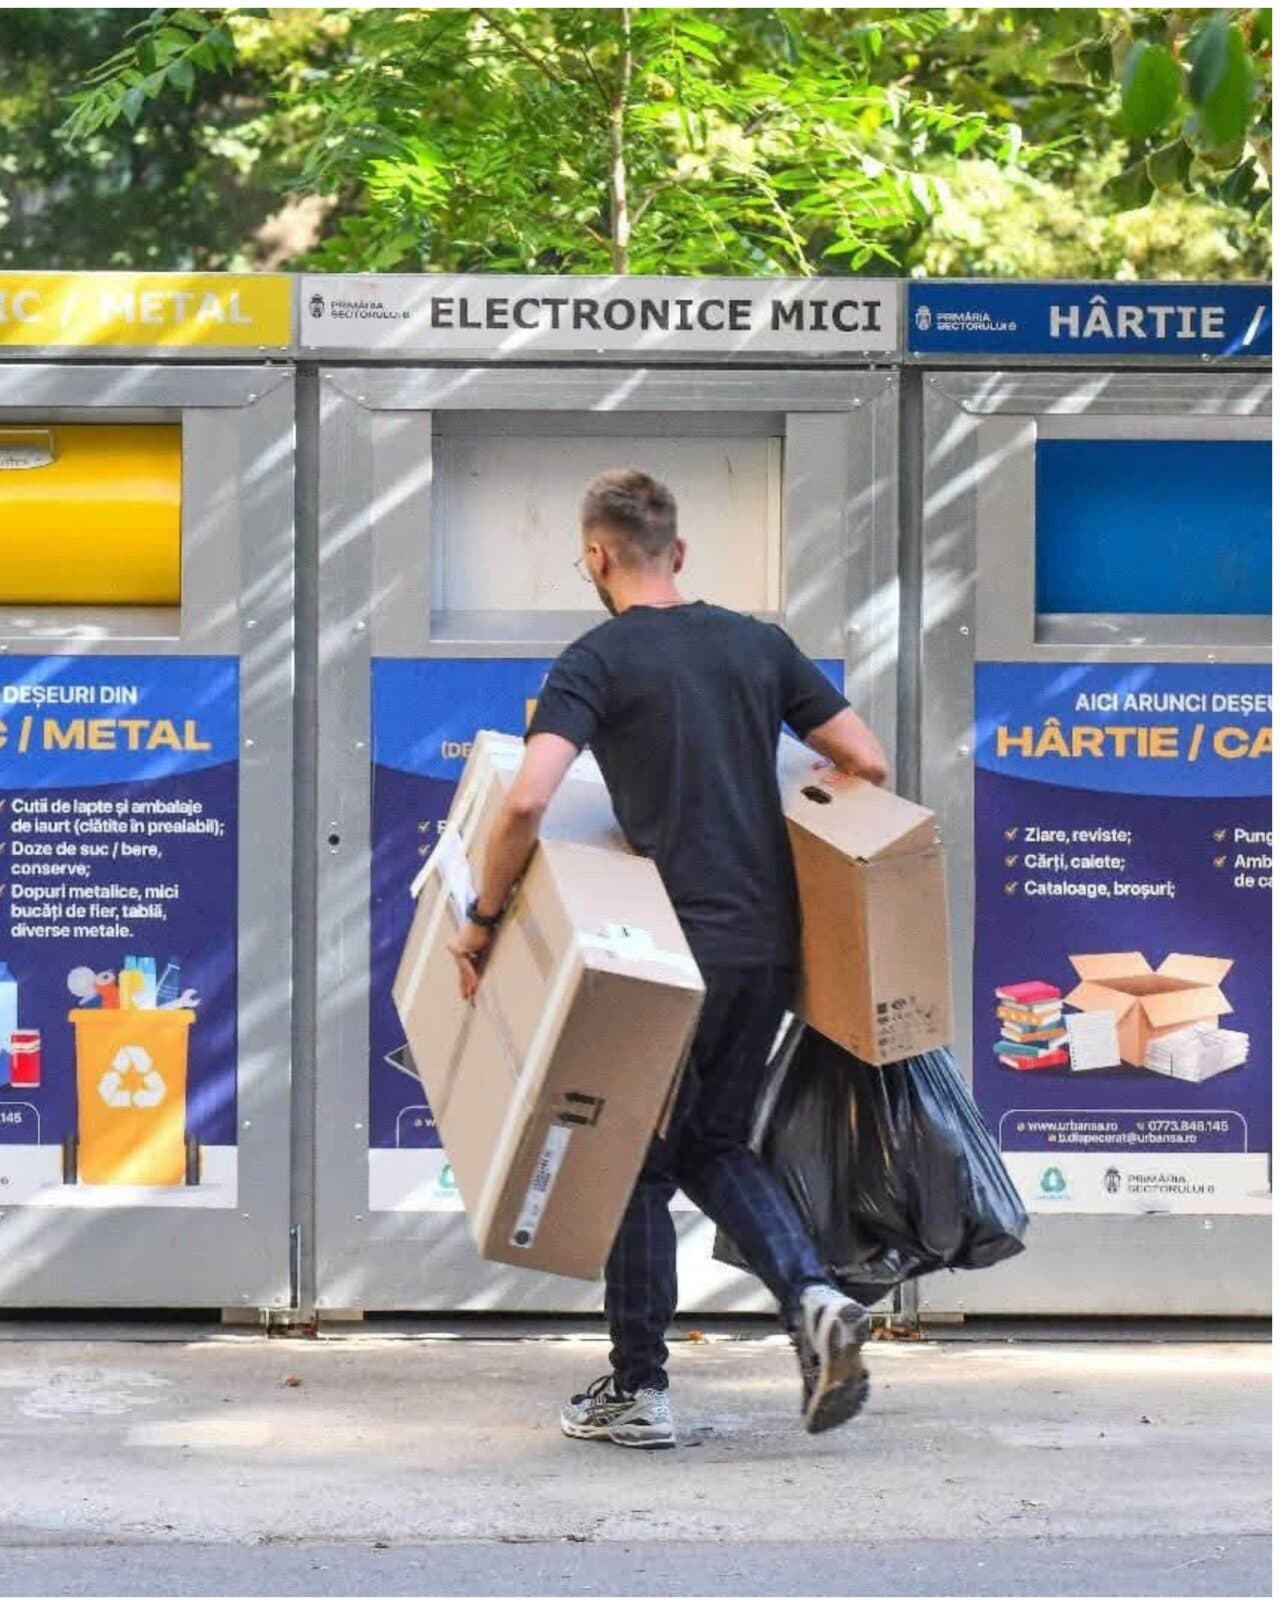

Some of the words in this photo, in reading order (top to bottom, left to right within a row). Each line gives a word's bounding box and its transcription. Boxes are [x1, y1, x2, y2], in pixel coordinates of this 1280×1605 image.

[99, 289, 252, 325] METAL
[429, 297, 752, 331] ELECTRONICE
[770, 299, 882, 332] MICI
[1049, 294, 1226, 339] HÂRTIE
[1241, 304, 1266, 346] /
[3, 685, 95, 710] DEȘEURI
[99, 685, 138, 704] DIN
[1075, 693, 1118, 712] AICI
[1123, 693, 1207, 713] ARUNCI
[17, 715, 34, 754] /
[42, 718, 213, 751] METAL
[996, 716, 1180, 758] HÂRTIE
[1187, 723, 1205, 762] /
[11, 798, 48, 814] Cutii
[51, 799, 71, 814] de
[73, 798, 114, 817] lapte
[130, 798, 204, 817] ambalaje
[11, 819, 32, 834] de
[34, 819, 72, 834] iaurt
[147, 818, 226, 838] prealabil);
[1024, 827, 1071, 845] Ziare,
[1072, 827, 1133, 846] reviste;
[11, 841, 53, 856] Doze
[55, 841, 77, 856] de
[79, 844, 109, 856] suc
[111, 842, 120, 860] /
[121, 841, 163, 860] bere,
[11, 862, 92, 878] conserve;
[1024, 853, 1069, 873] Cărți,
[1070, 853, 1126, 872] caiete;
[1024, 879, 1111, 898] Cataloage,
[1233, 873, 1255, 888] de
[11, 883, 67, 902] Dopuri
[68, 883, 143, 901] metalice,
[144, 883, 180, 899] mici
[11, 903, 63, 923] bucăți
[65, 903, 87, 918] de
[88, 902, 120, 920] fier,
[122, 903, 168, 921] tablă,
[11, 923, 71, 938] diverse
[72, 923, 135, 938] metale.
